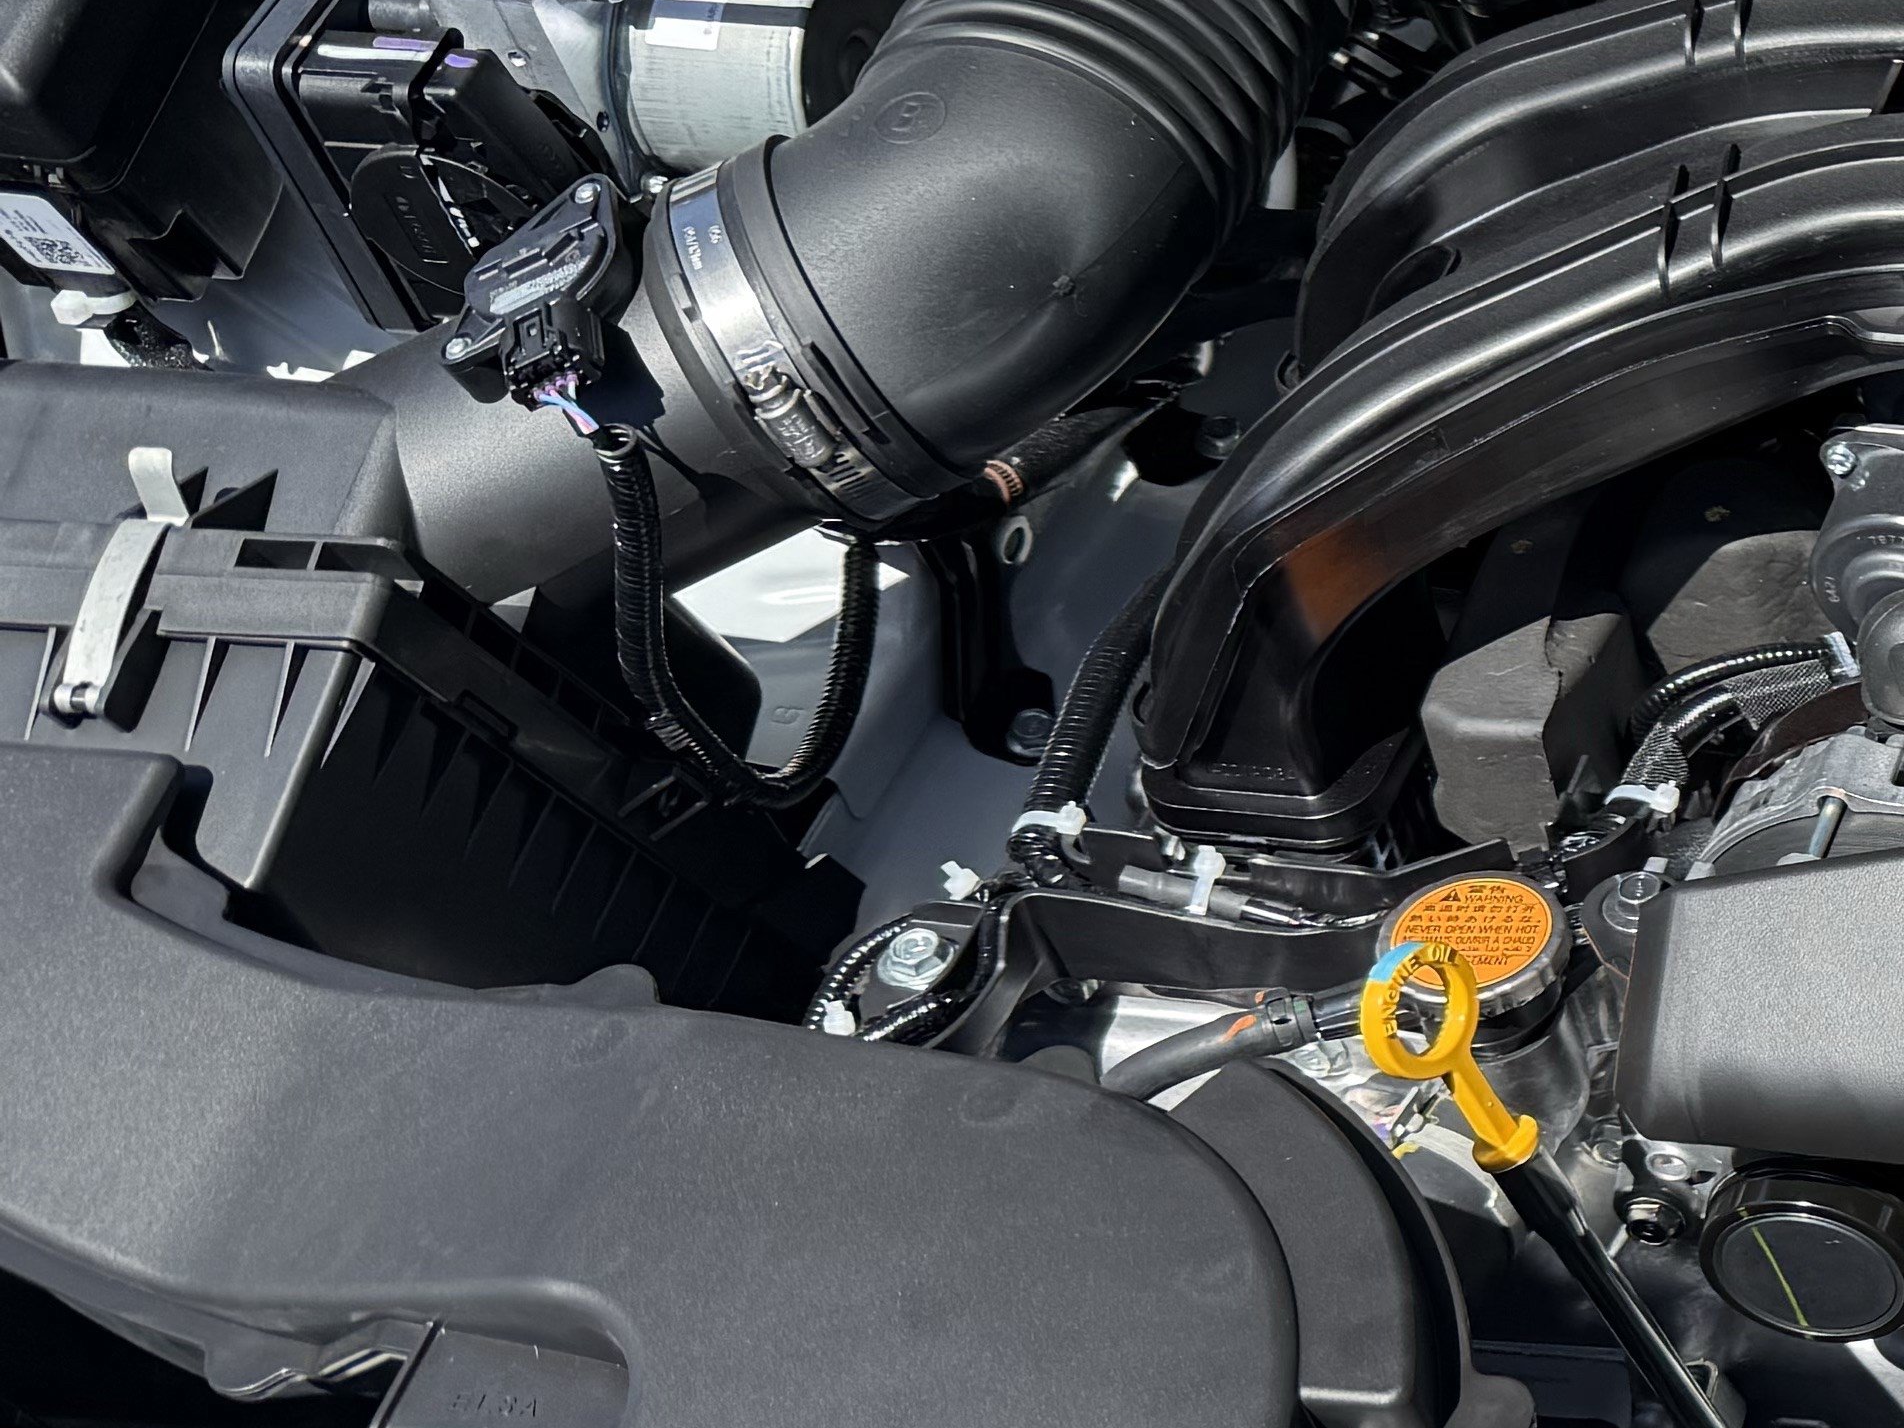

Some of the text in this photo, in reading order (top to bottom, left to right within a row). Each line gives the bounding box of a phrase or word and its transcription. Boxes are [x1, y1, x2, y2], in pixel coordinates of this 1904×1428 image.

[1463, 893, 1524, 904] WARNING
[1404, 923, 1539, 935] NEVER OPEN WHEN HOT
[1381, 943, 1452, 1036] ENGINE OIL
